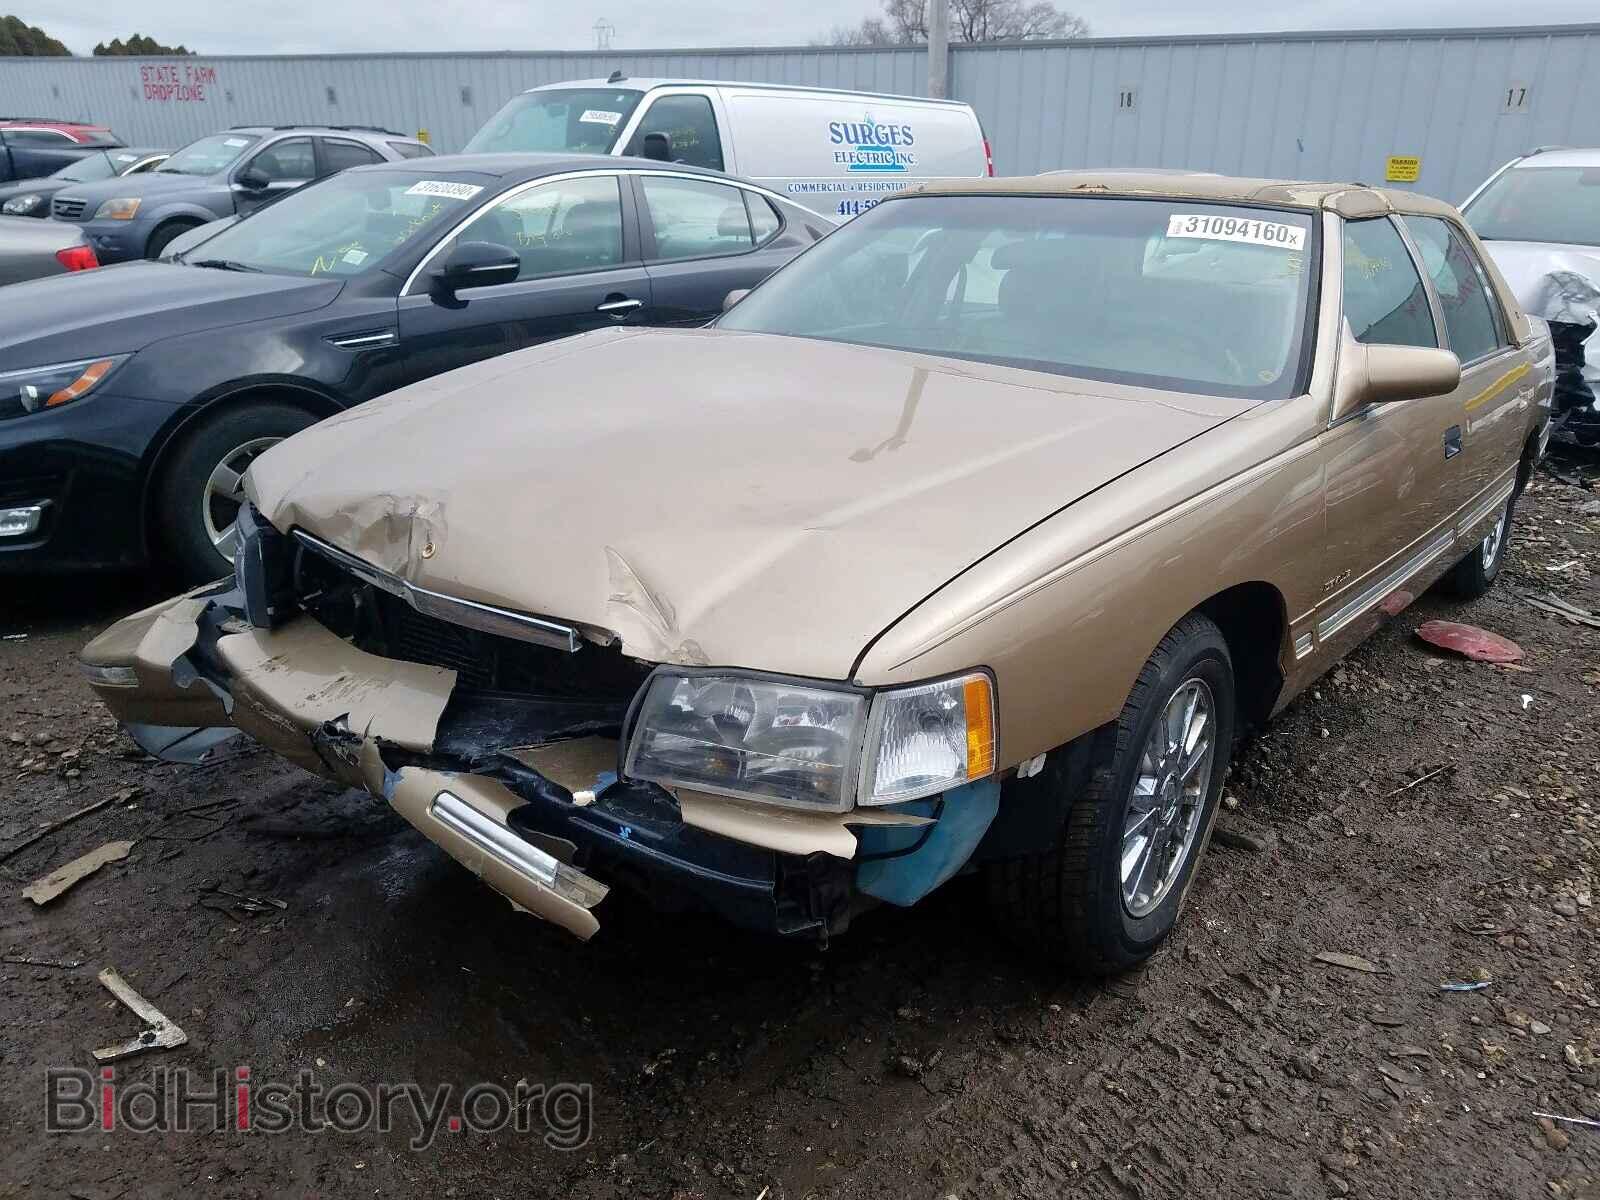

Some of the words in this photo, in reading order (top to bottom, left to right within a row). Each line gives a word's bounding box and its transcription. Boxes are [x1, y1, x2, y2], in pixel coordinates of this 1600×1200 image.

[141, 65, 179, 82] STATE
[186, 65, 216, 82] FARM
[144, 84, 205, 101] DROPZONE
[1120, 92, 1132, 108] 18
[1507, 88, 1526, 106] 17
[829, 121, 914, 146] SURGES
[834, 151, 895, 164] ELECTRIC
[788, 183, 847, 193] COMMERCIAL
